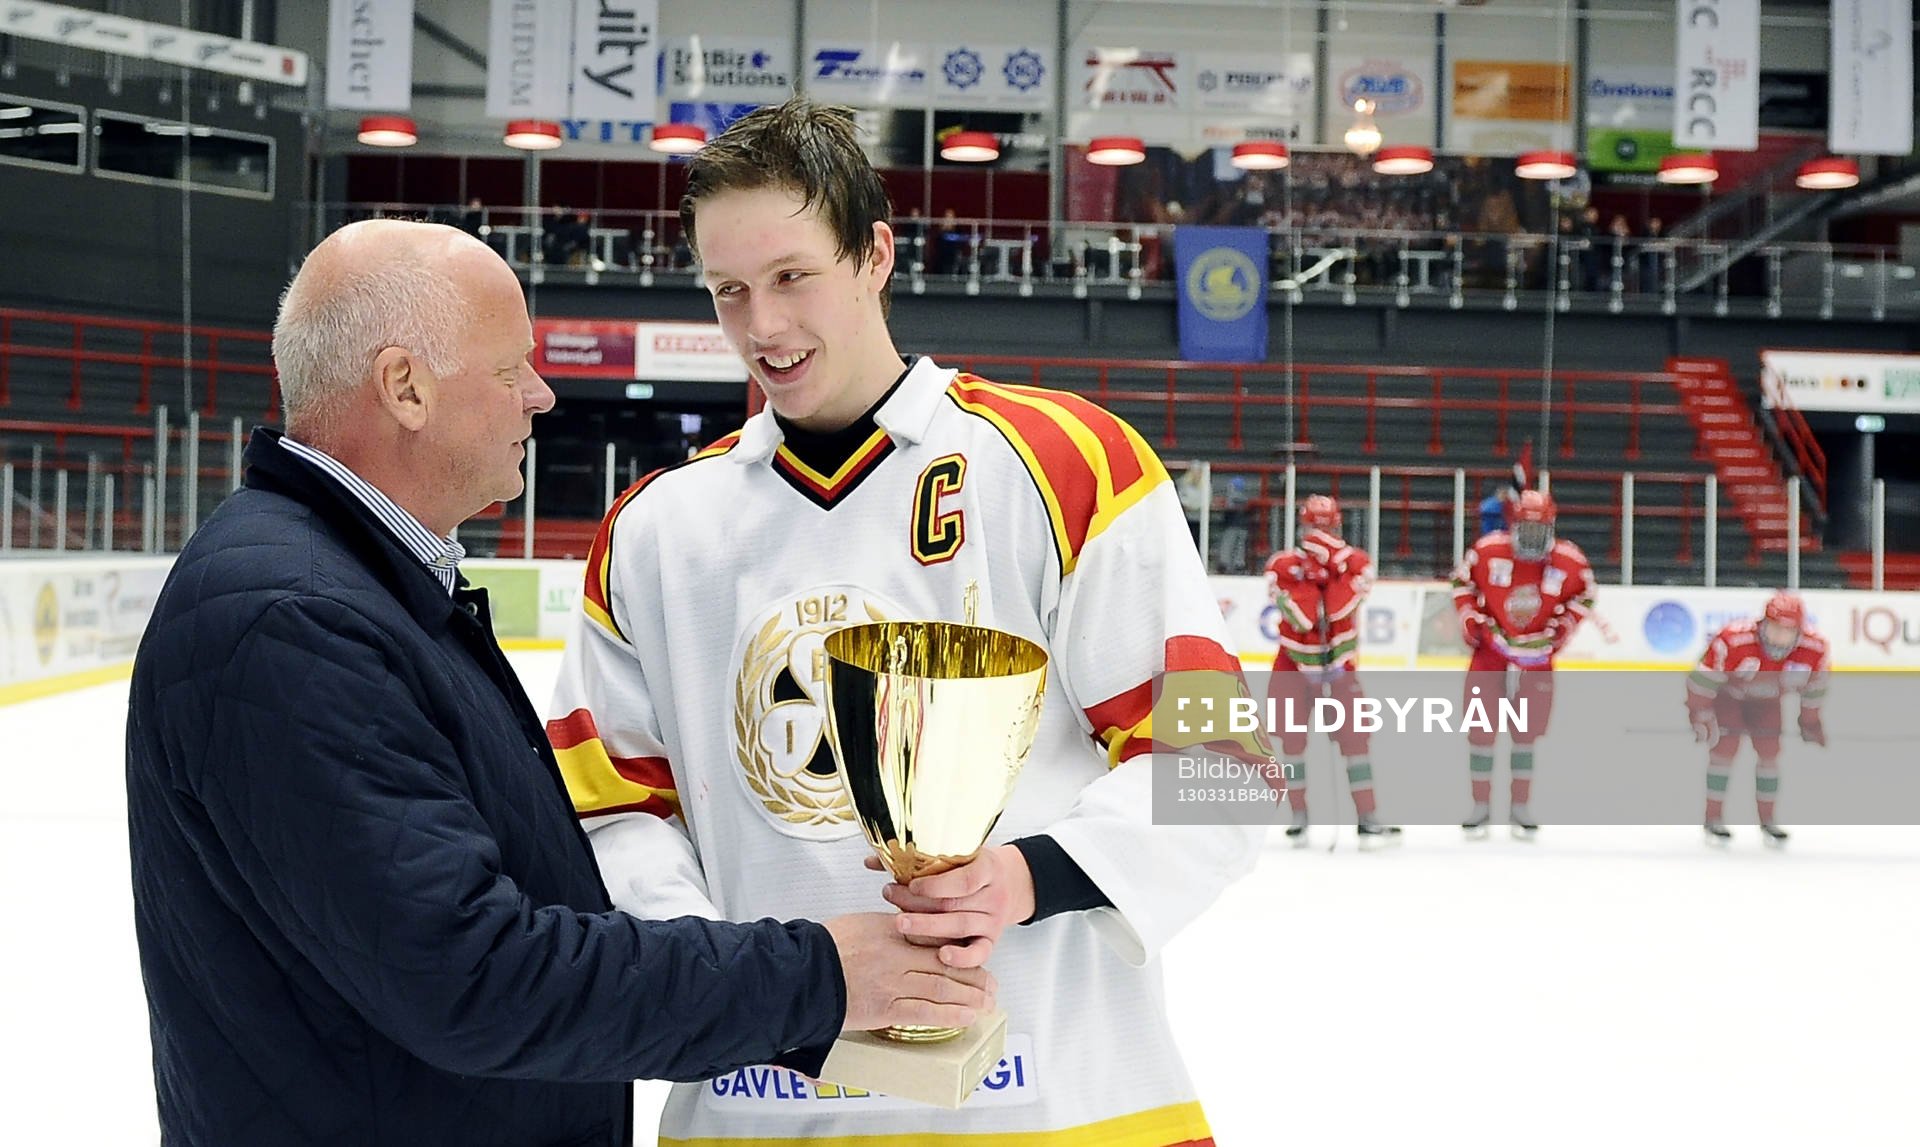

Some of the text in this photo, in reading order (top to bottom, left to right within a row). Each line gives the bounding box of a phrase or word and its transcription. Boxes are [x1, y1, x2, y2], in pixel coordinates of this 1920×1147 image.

[673, 66, 786, 86] Slutions
[1689, 67, 1717, 138] RCC
[910, 452, 967, 567] C
[796, 594, 848, 626] 1912
